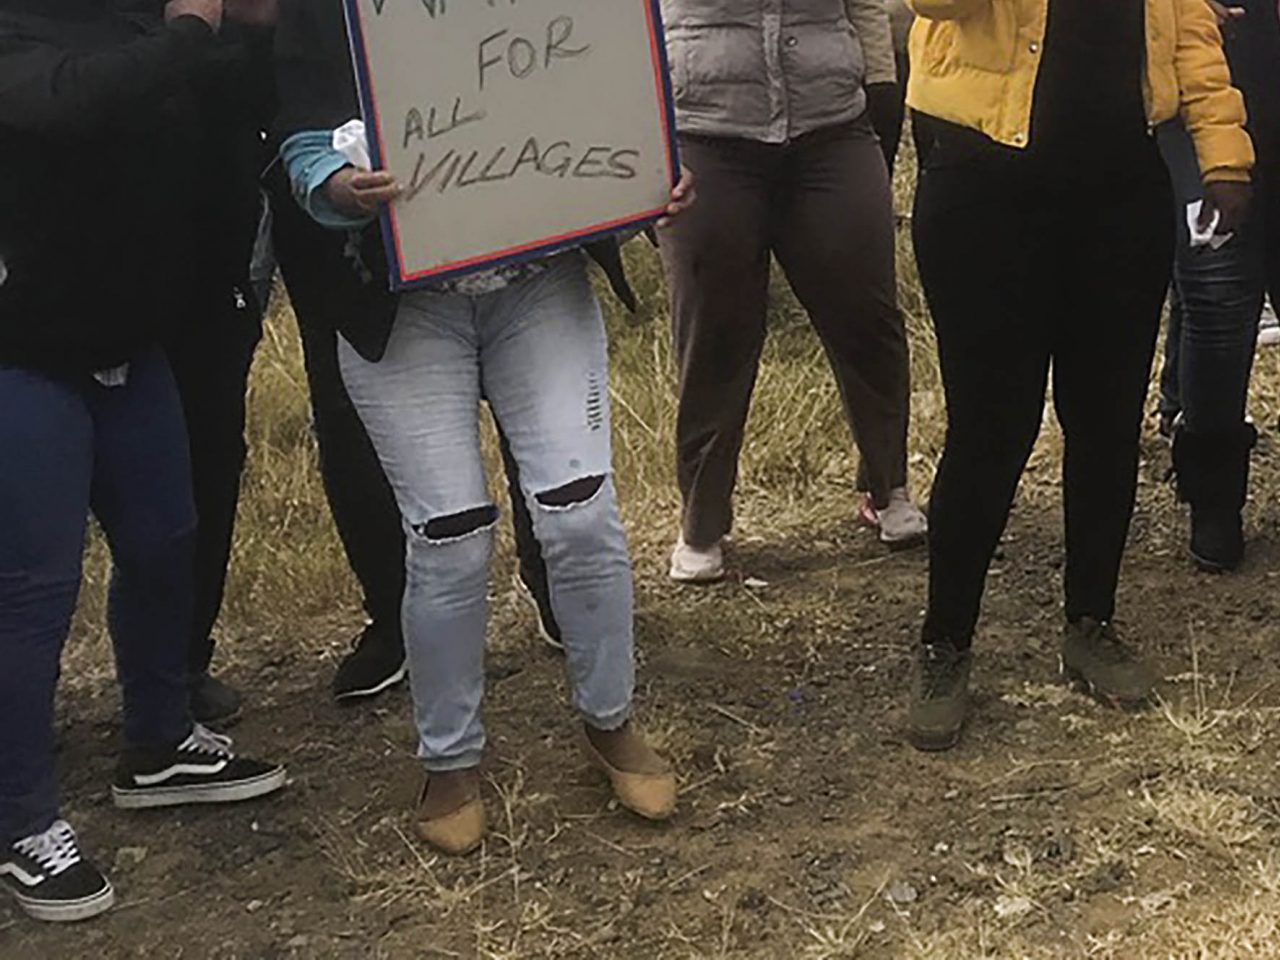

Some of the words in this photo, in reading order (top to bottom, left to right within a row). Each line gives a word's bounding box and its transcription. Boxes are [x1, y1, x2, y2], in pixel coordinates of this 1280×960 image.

[477, 15, 591, 91] FOR
[402, 97, 486, 148] ALL
[400, 137, 640, 204] VILLAGES
